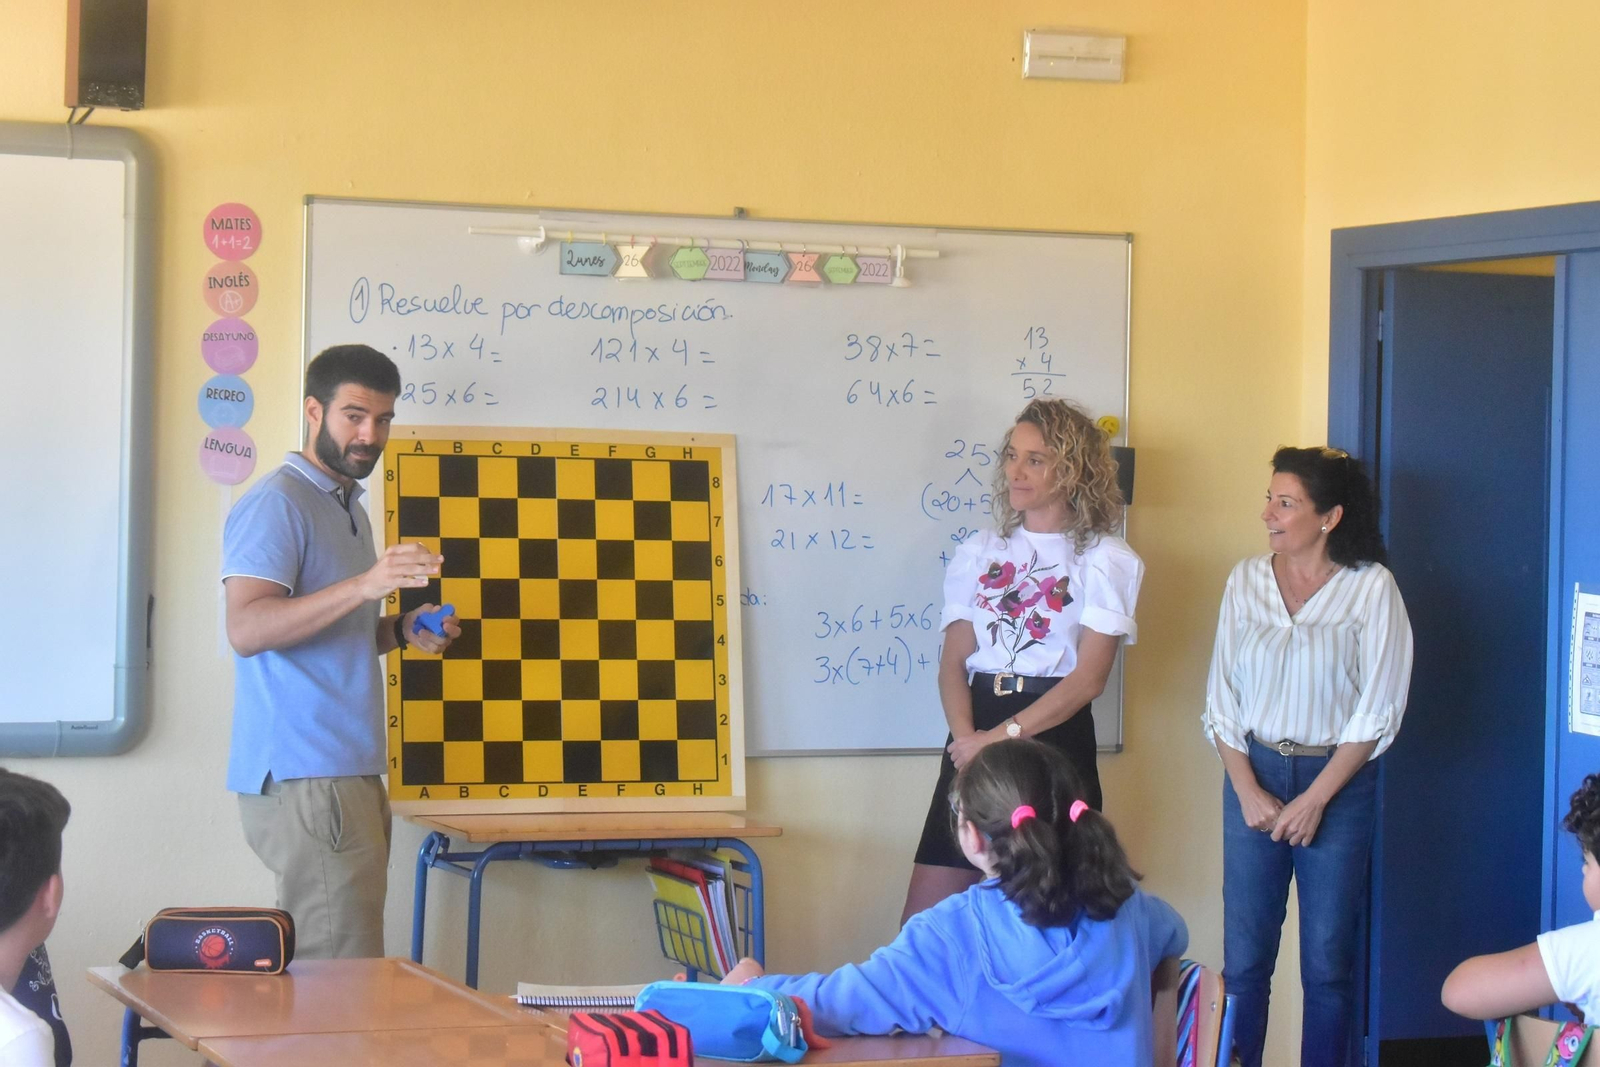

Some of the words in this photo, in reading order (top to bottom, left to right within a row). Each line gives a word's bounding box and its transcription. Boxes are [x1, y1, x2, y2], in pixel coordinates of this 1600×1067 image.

[211, 218, 252, 231] MATES
[566, 249, 606, 268] Lunes
[623, 254, 639, 267] 26
[710, 255, 741, 272] 2022
[862, 262, 888, 277] 2022
[208, 272, 249, 289] INGLÉS
[379, 284, 489, 316] Resuelve
[501, 301, 541, 336] por
[202, 331, 255, 342] DESAYUNO
[1023, 326, 1049, 350] 13
[206, 387, 246, 403] RECREO
[204, 437, 252, 458] LENGUA
[414, 441, 424, 452] A
[453, 442, 462, 453] B
[492, 442, 502, 454] C
[531, 443, 541, 455] D
[571, 445, 579, 456] E
[609, 445, 617, 457] F
[645, 447, 656, 458] G
[683, 448, 692, 459] H
[386, 469, 394, 482] 8
[712, 476, 720, 488] 8
[387, 511, 394, 522] 7
[713, 516, 721, 527] 7
[715, 555, 723, 567] 6
[716, 595, 724, 606] 5
[717, 635, 725, 646] 4
[389, 674, 397, 686] 3
[718, 674, 726, 686] 3
[390, 715, 398, 727] 2
[720, 714, 728, 725] 2
[391, 757, 397, 769] 1
[721, 754, 727, 765] 1
[419, 787, 430, 798] A
[460, 786, 469, 798] B
[499, 786, 509, 798] C
[538, 786, 548, 797] D
[579, 785, 587, 797] E
[618, 785, 625, 796] F
[654, 784, 665, 796] G
[693, 783, 702, 795] H
[195, 928, 234, 946] BASKETBALL
